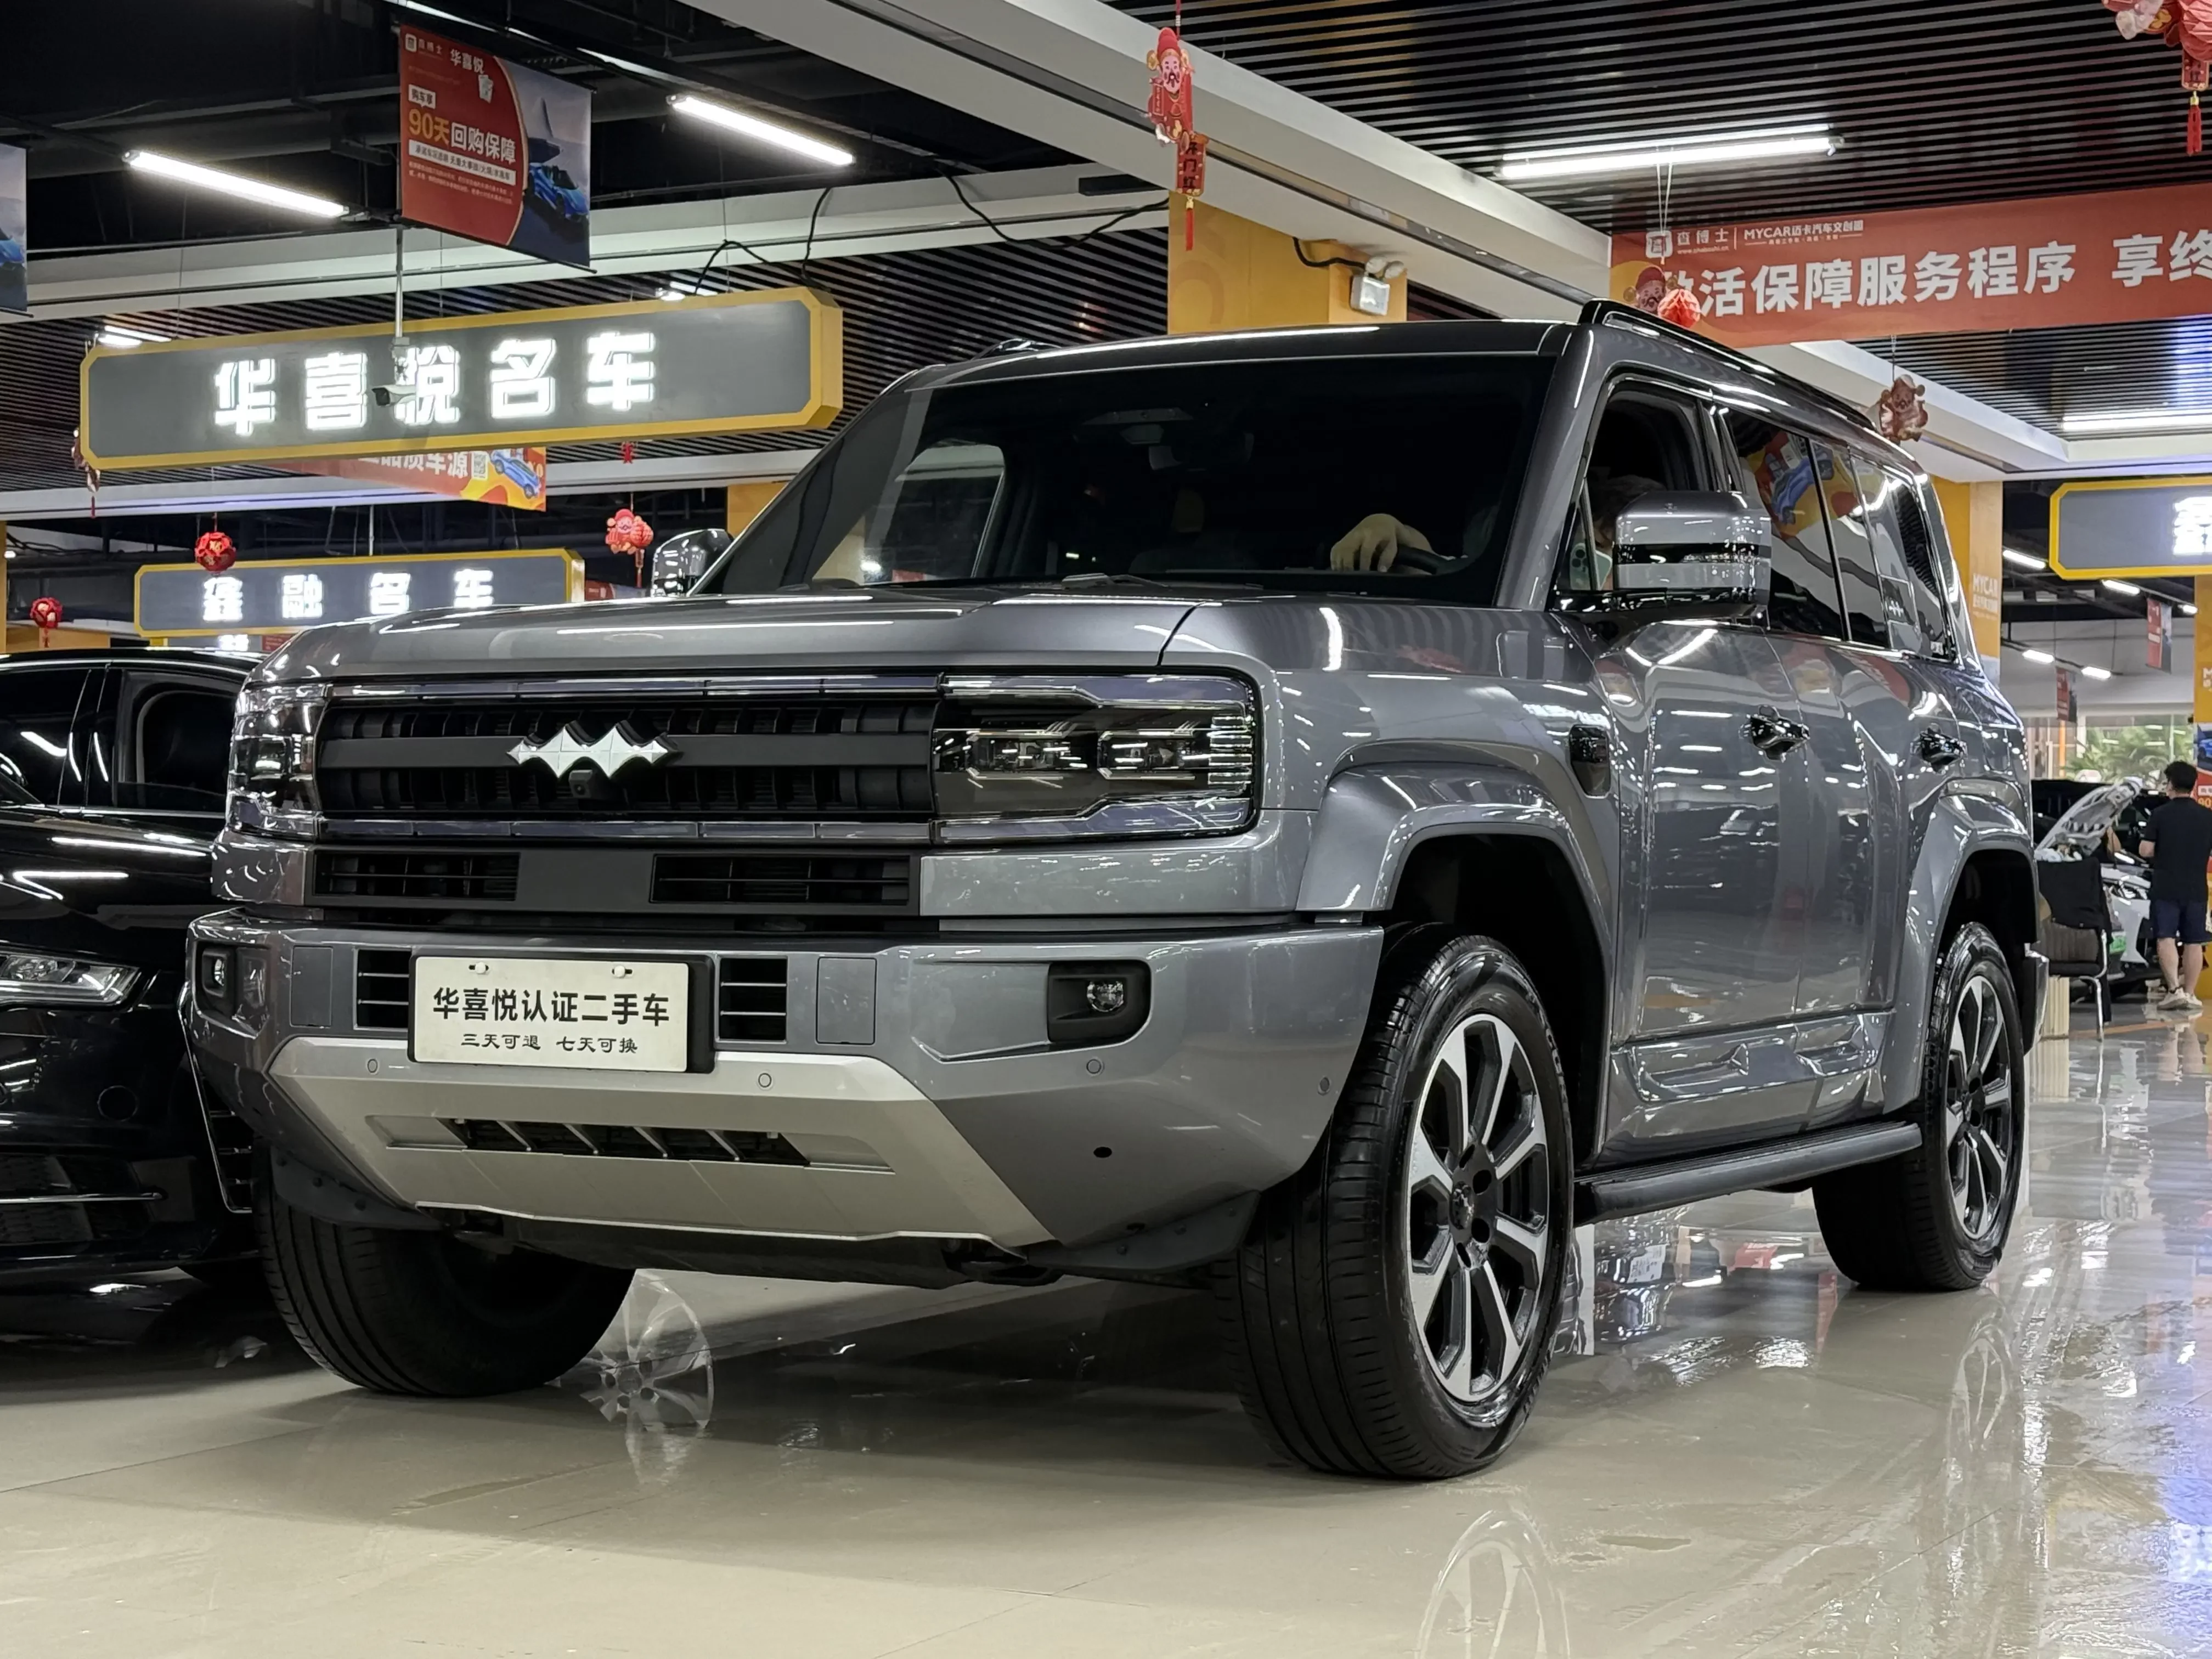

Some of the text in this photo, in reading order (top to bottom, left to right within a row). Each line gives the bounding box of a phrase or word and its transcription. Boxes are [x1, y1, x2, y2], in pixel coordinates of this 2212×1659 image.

[215, 331, 656, 437] 华喜悦名车
[358, 451, 469, 479] 质车源
[433, 987, 670, 1026] 华喜悦认证二手车
[461, 1033, 638, 1054] 三天可退 七天可换
